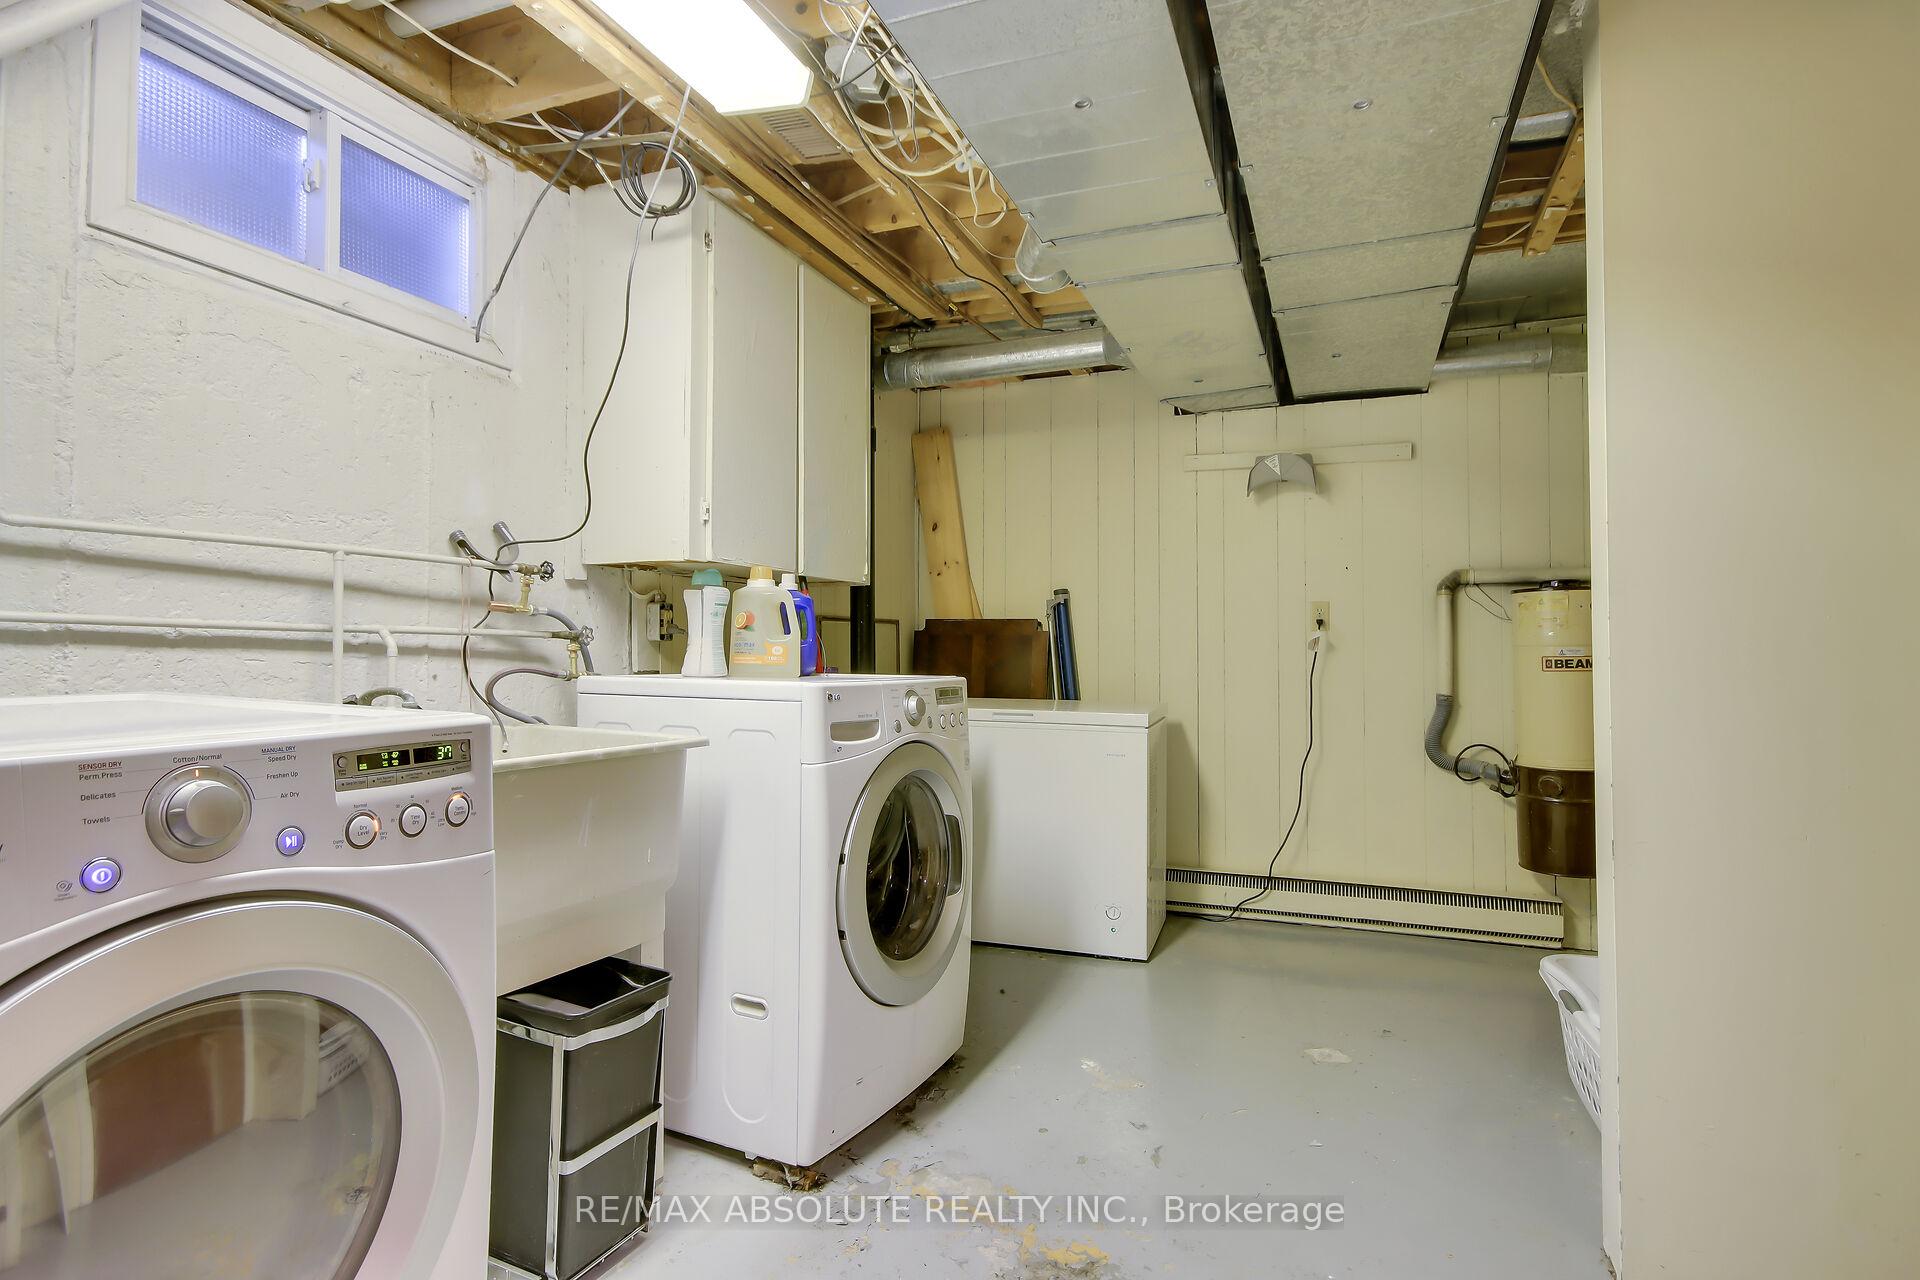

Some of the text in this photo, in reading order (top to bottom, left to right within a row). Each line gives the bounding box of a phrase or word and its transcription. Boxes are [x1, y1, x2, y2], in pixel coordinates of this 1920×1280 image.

[261, 746, 284, 754] MANUAL
[437, 745, 452, 760] 37
[172, 753, 223, 764] Cotton/Normal
[267, 754, 297, 763] Speed Dry
[78, 761, 122, 771] SENSOR DRY
[101, 770, 123, 779] Press
[266, 771, 299, 780] Freshen Up
[80, 791, 116, 802] Delicates
[280, 790, 300, 799] Air Dry
[82, 815, 111, 825] Towels
